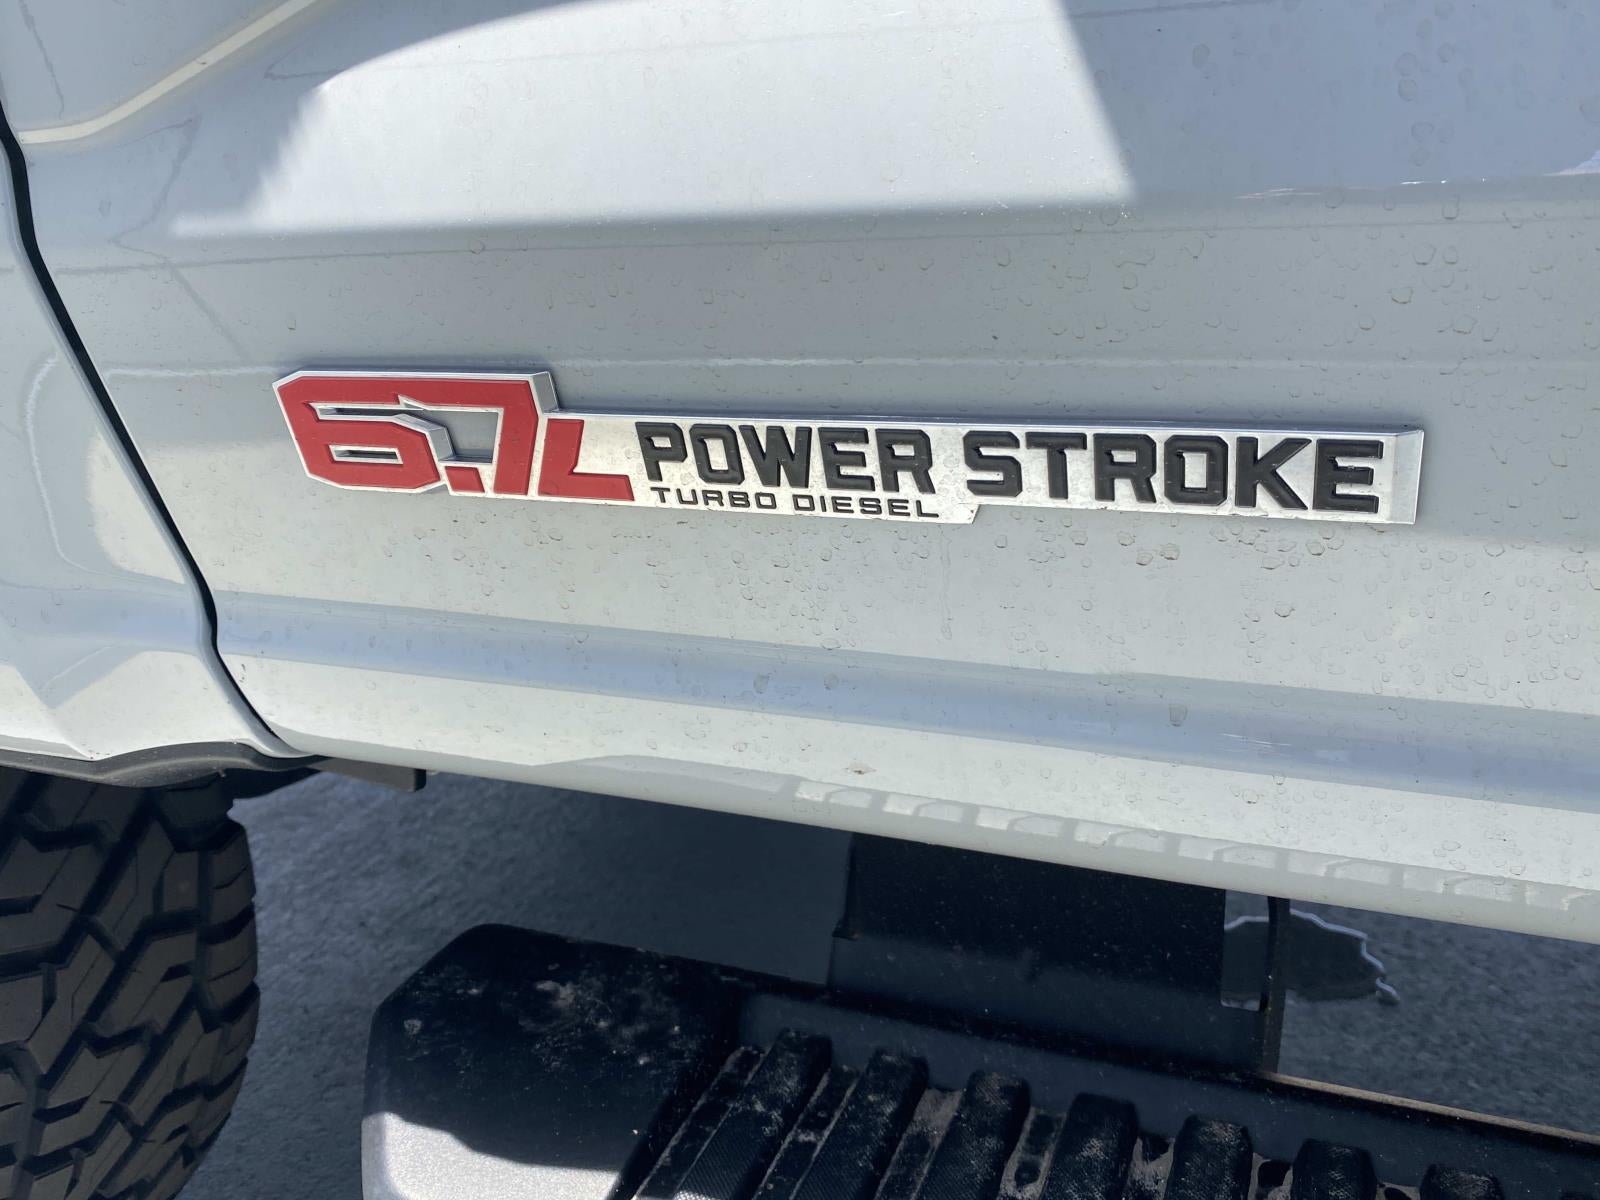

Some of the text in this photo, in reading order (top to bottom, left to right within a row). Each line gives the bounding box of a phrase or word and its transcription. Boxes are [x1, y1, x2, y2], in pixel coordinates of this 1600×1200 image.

[276, 376, 1384, 514] 6.7L POWER STROKE
[650, 486, 940, 518] TURBO DIESEL
